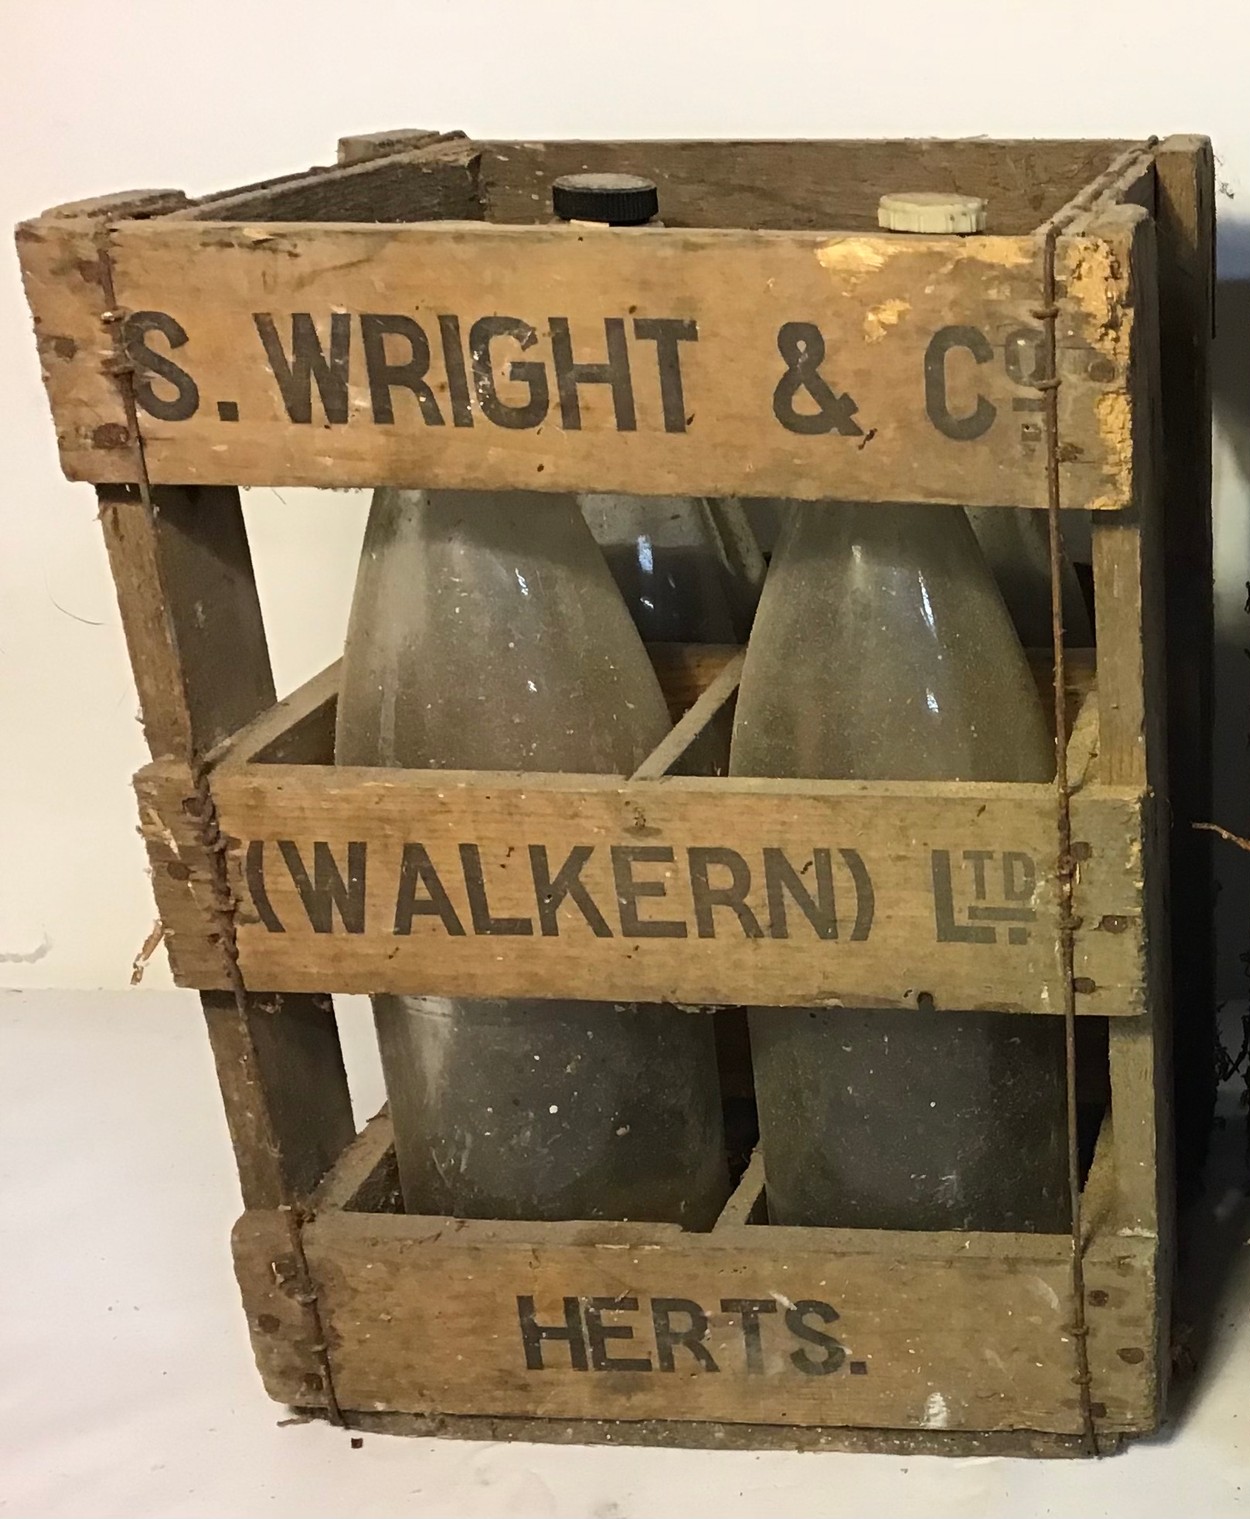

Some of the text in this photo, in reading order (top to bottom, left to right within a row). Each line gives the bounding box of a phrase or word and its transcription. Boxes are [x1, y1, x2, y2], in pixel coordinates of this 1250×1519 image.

[124, 311, 239, 422] S.
[252, 313, 699, 433] WRIGHT
[773, 322, 864, 437] &
[246, 839, 875, 942] (WALKERN)
[516, 1295, 867, 1377] HERTS.
